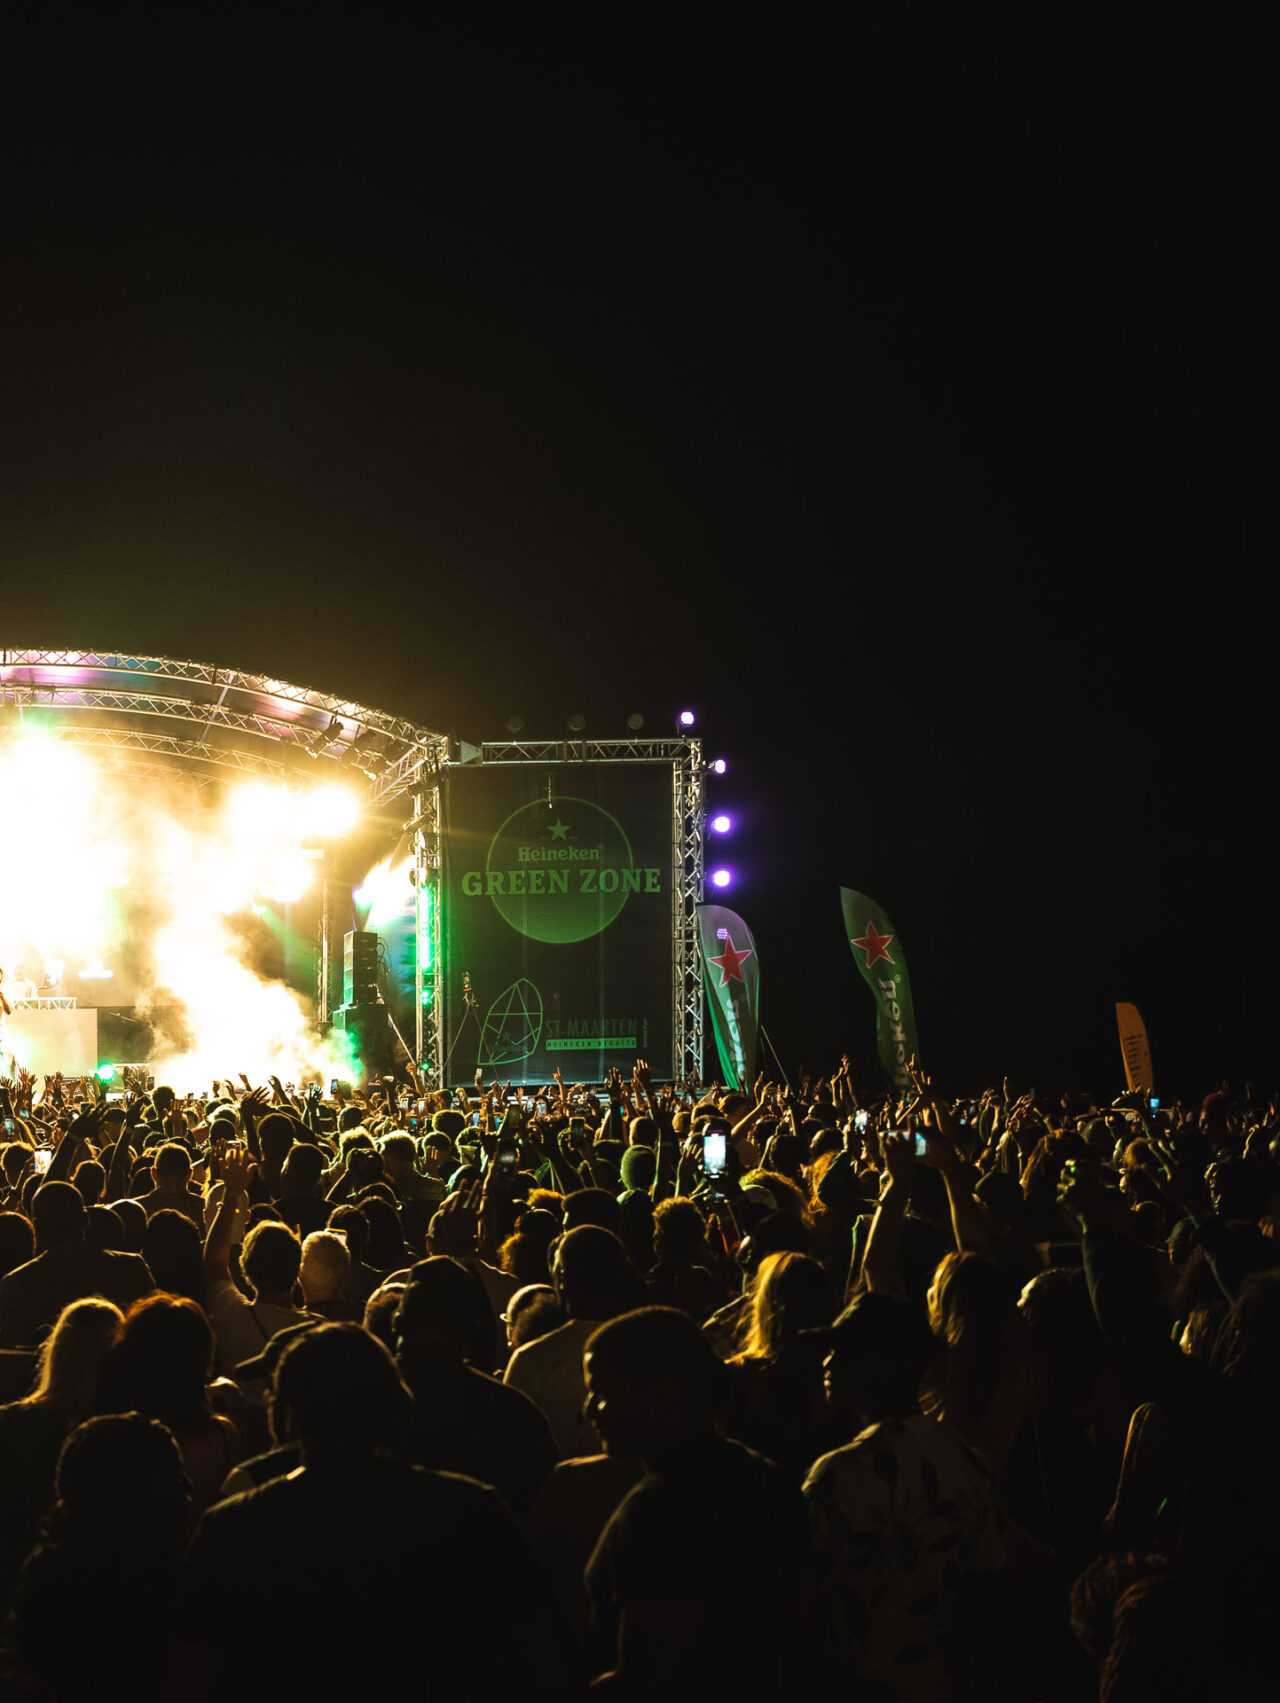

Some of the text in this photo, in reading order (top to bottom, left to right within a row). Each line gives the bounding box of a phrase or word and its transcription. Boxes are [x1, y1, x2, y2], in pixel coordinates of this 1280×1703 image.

[518, 846, 601, 862] Heineken
[461, 868, 661, 896] GREEN ZONE
